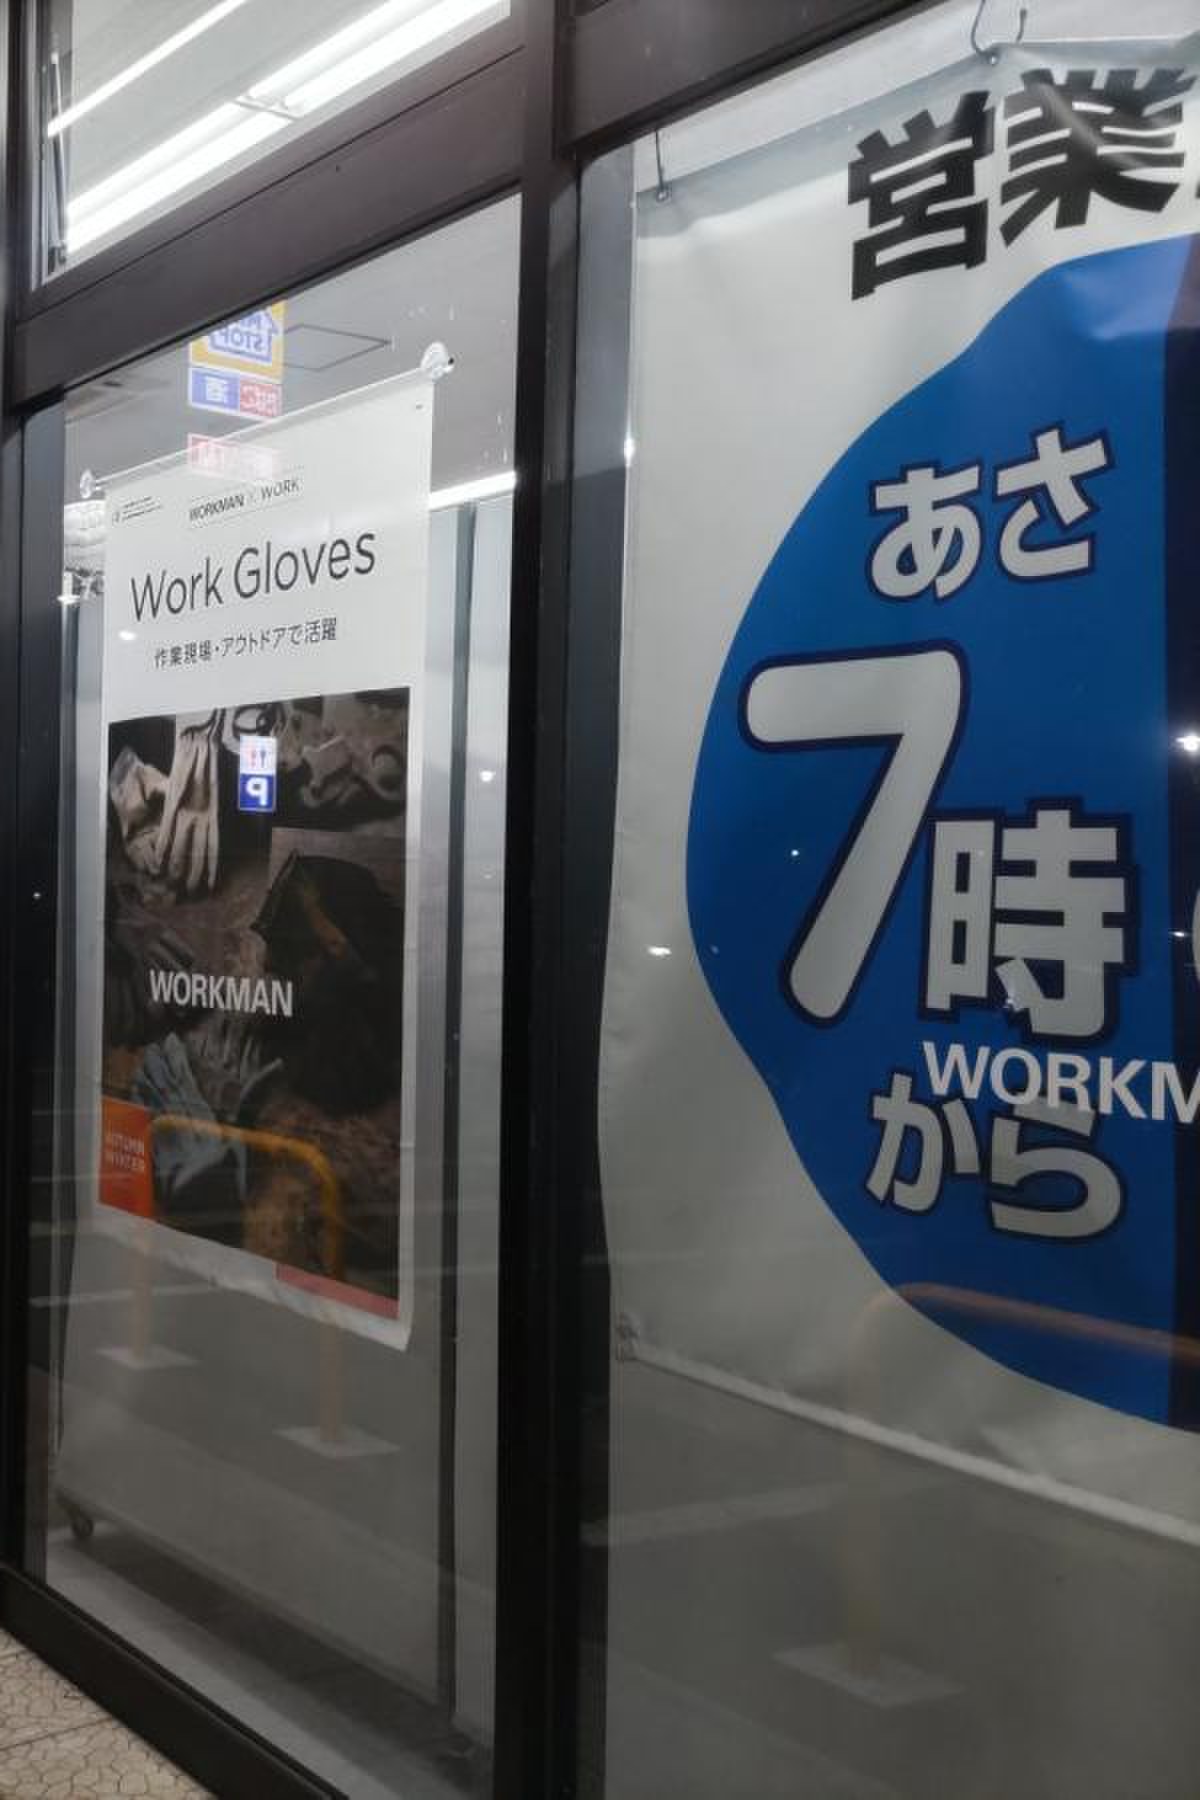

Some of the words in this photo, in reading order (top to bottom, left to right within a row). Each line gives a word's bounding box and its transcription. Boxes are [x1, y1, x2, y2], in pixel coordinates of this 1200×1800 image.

[849, 67, 1200, 301] 営業
[189, 494, 245, 522] WORKMAN
[259, 478, 300, 501] WORK
[871, 427, 1109, 601] あさ
[131, 555, 224, 622] Work
[233, 532, 376, 599] Gloves
[154, 616, 338, 669] 作業現場・アウトドアで活躍
[149, 967, 294, 1018] WORKMAN
[865, 1072, 1121, 1237] から
